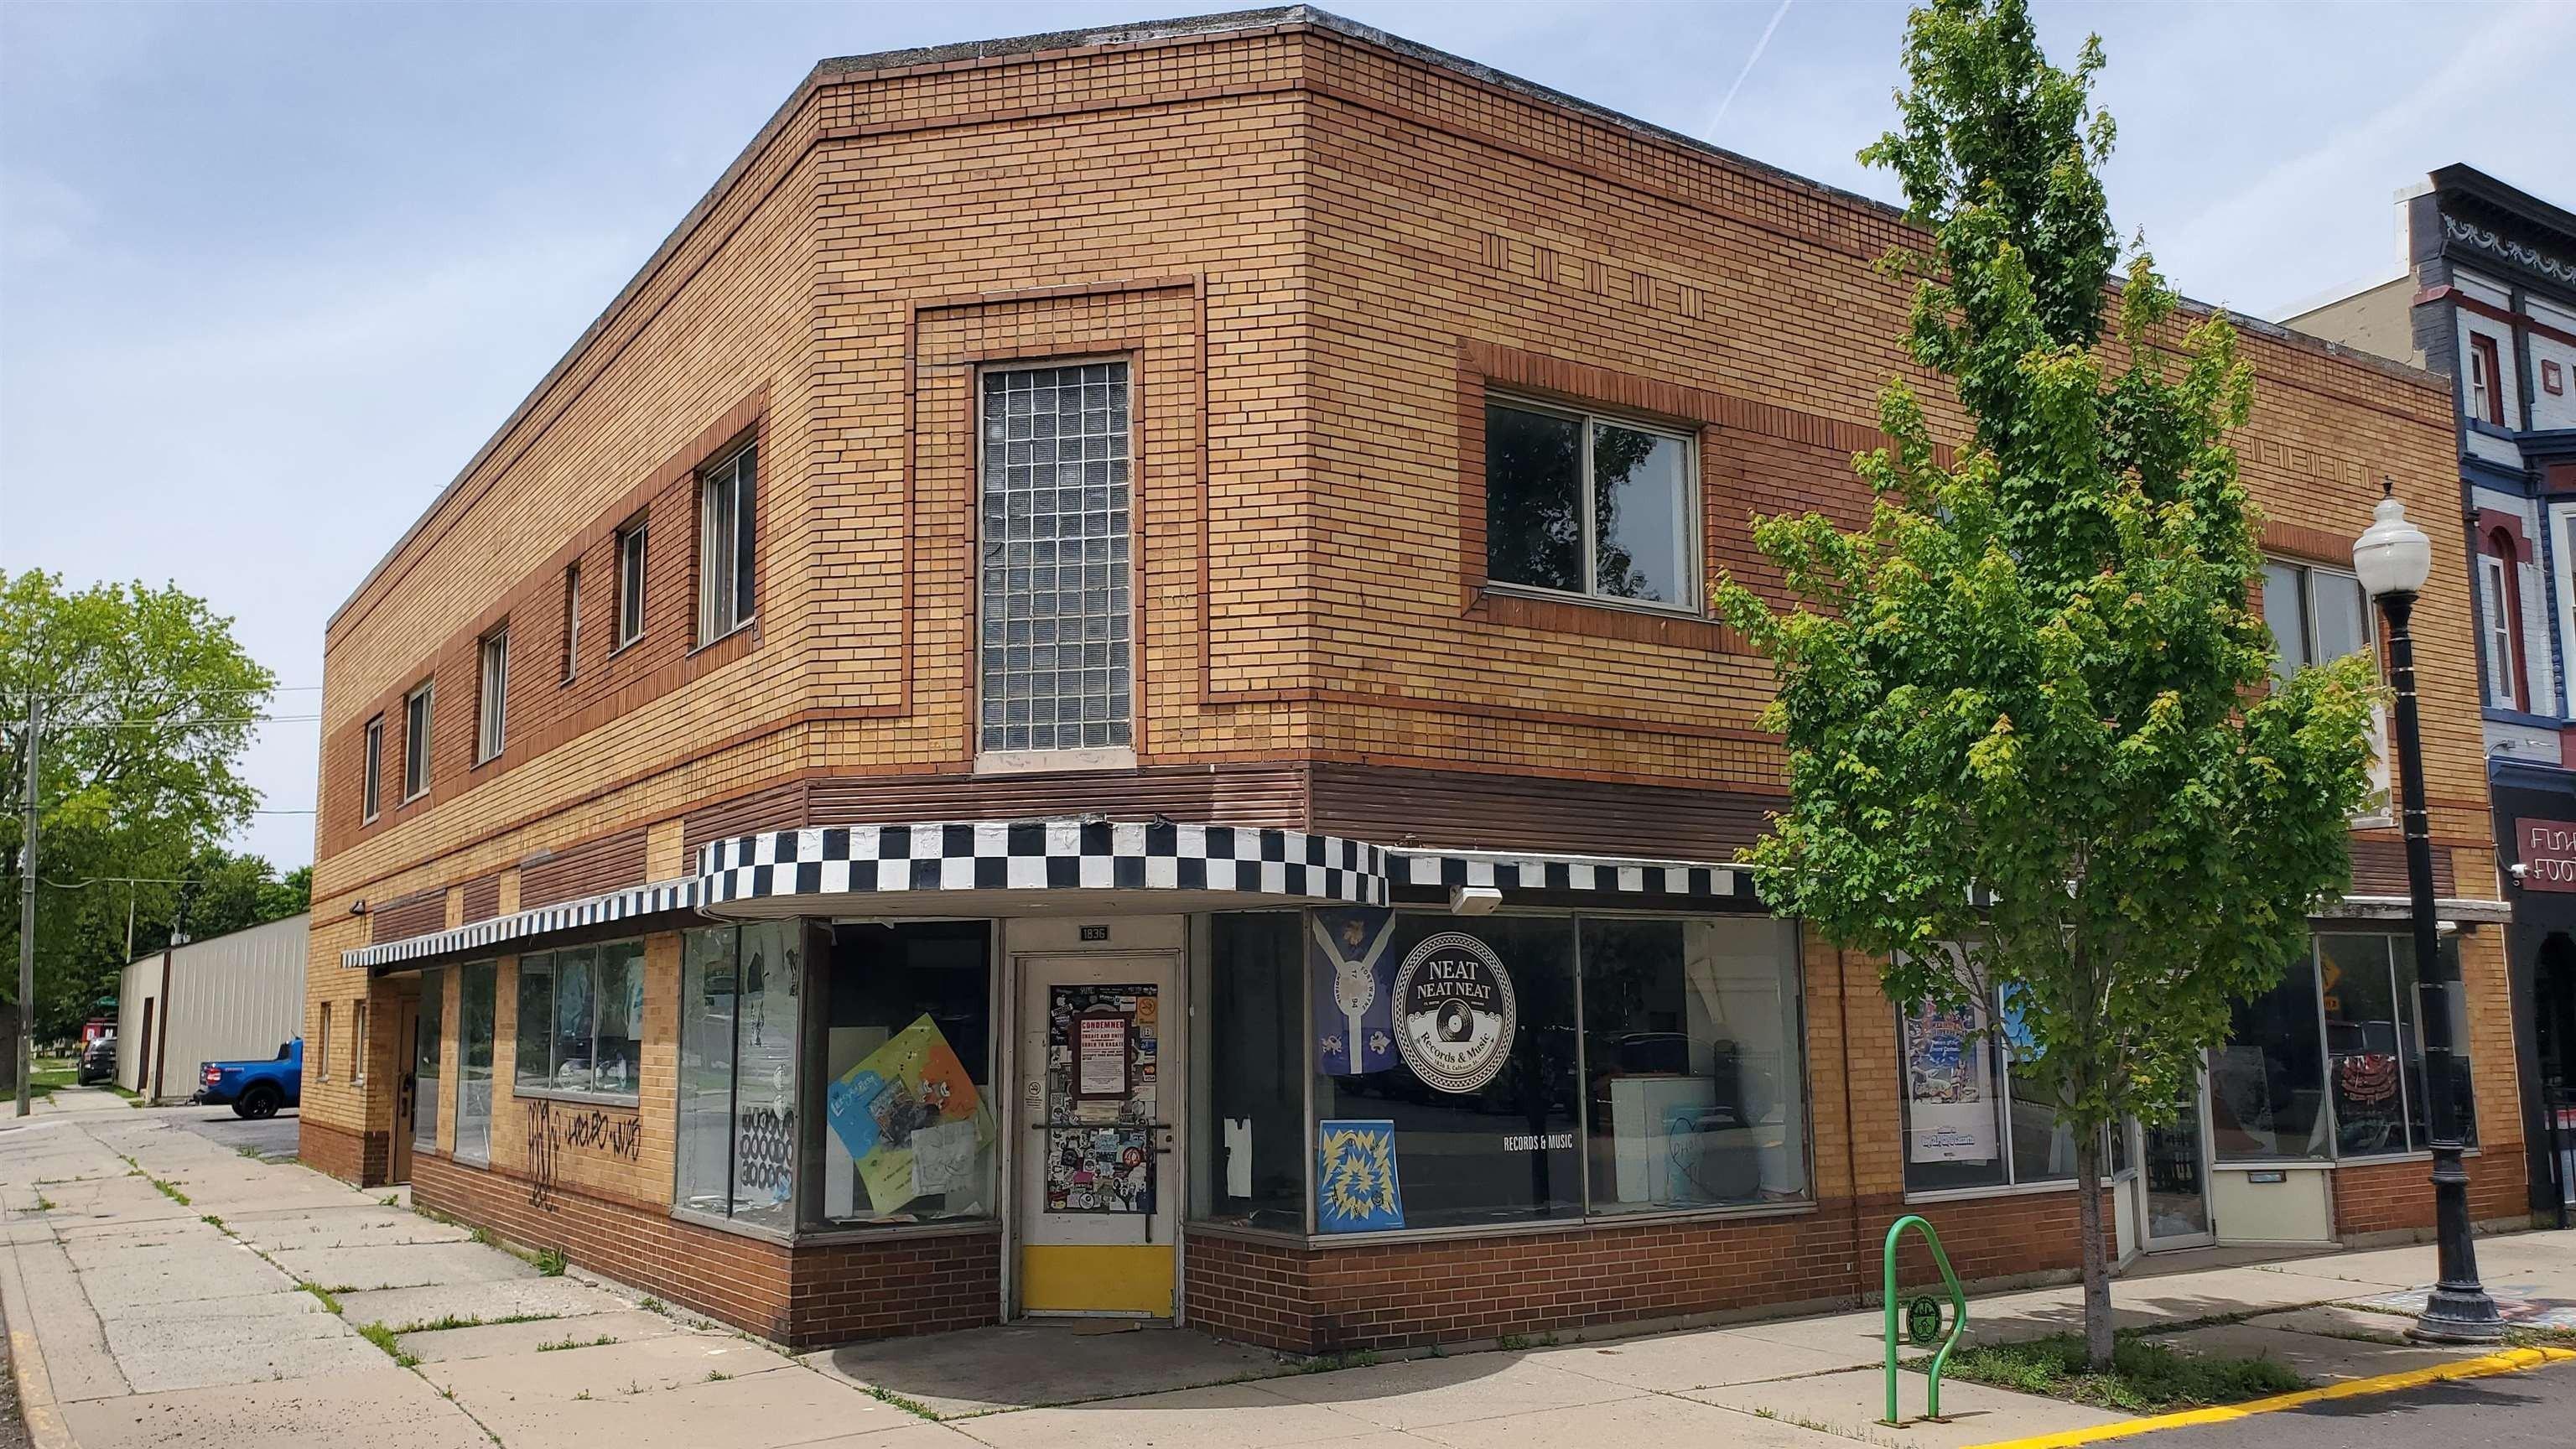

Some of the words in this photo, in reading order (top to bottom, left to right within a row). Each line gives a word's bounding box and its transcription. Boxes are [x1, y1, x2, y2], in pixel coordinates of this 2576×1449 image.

[1083, 928, 1106, 939] 1836
[1429, 960, 1478, 980] NEAT
[1417, 982, 1452, 999] NEAT
[1456, 982, 1491, 999] NEAT
[1421, 1031, 1456, 1063] Records
[1457, 1052, 1467, 1063] &
[1466, 1032, 1490, 1060] Music
[1504, 1135, 1539, 1151] RECORDS
[1540, 1135, 1546, 1150] &
[1548, 1134, 1572, 1149] MUSIC
